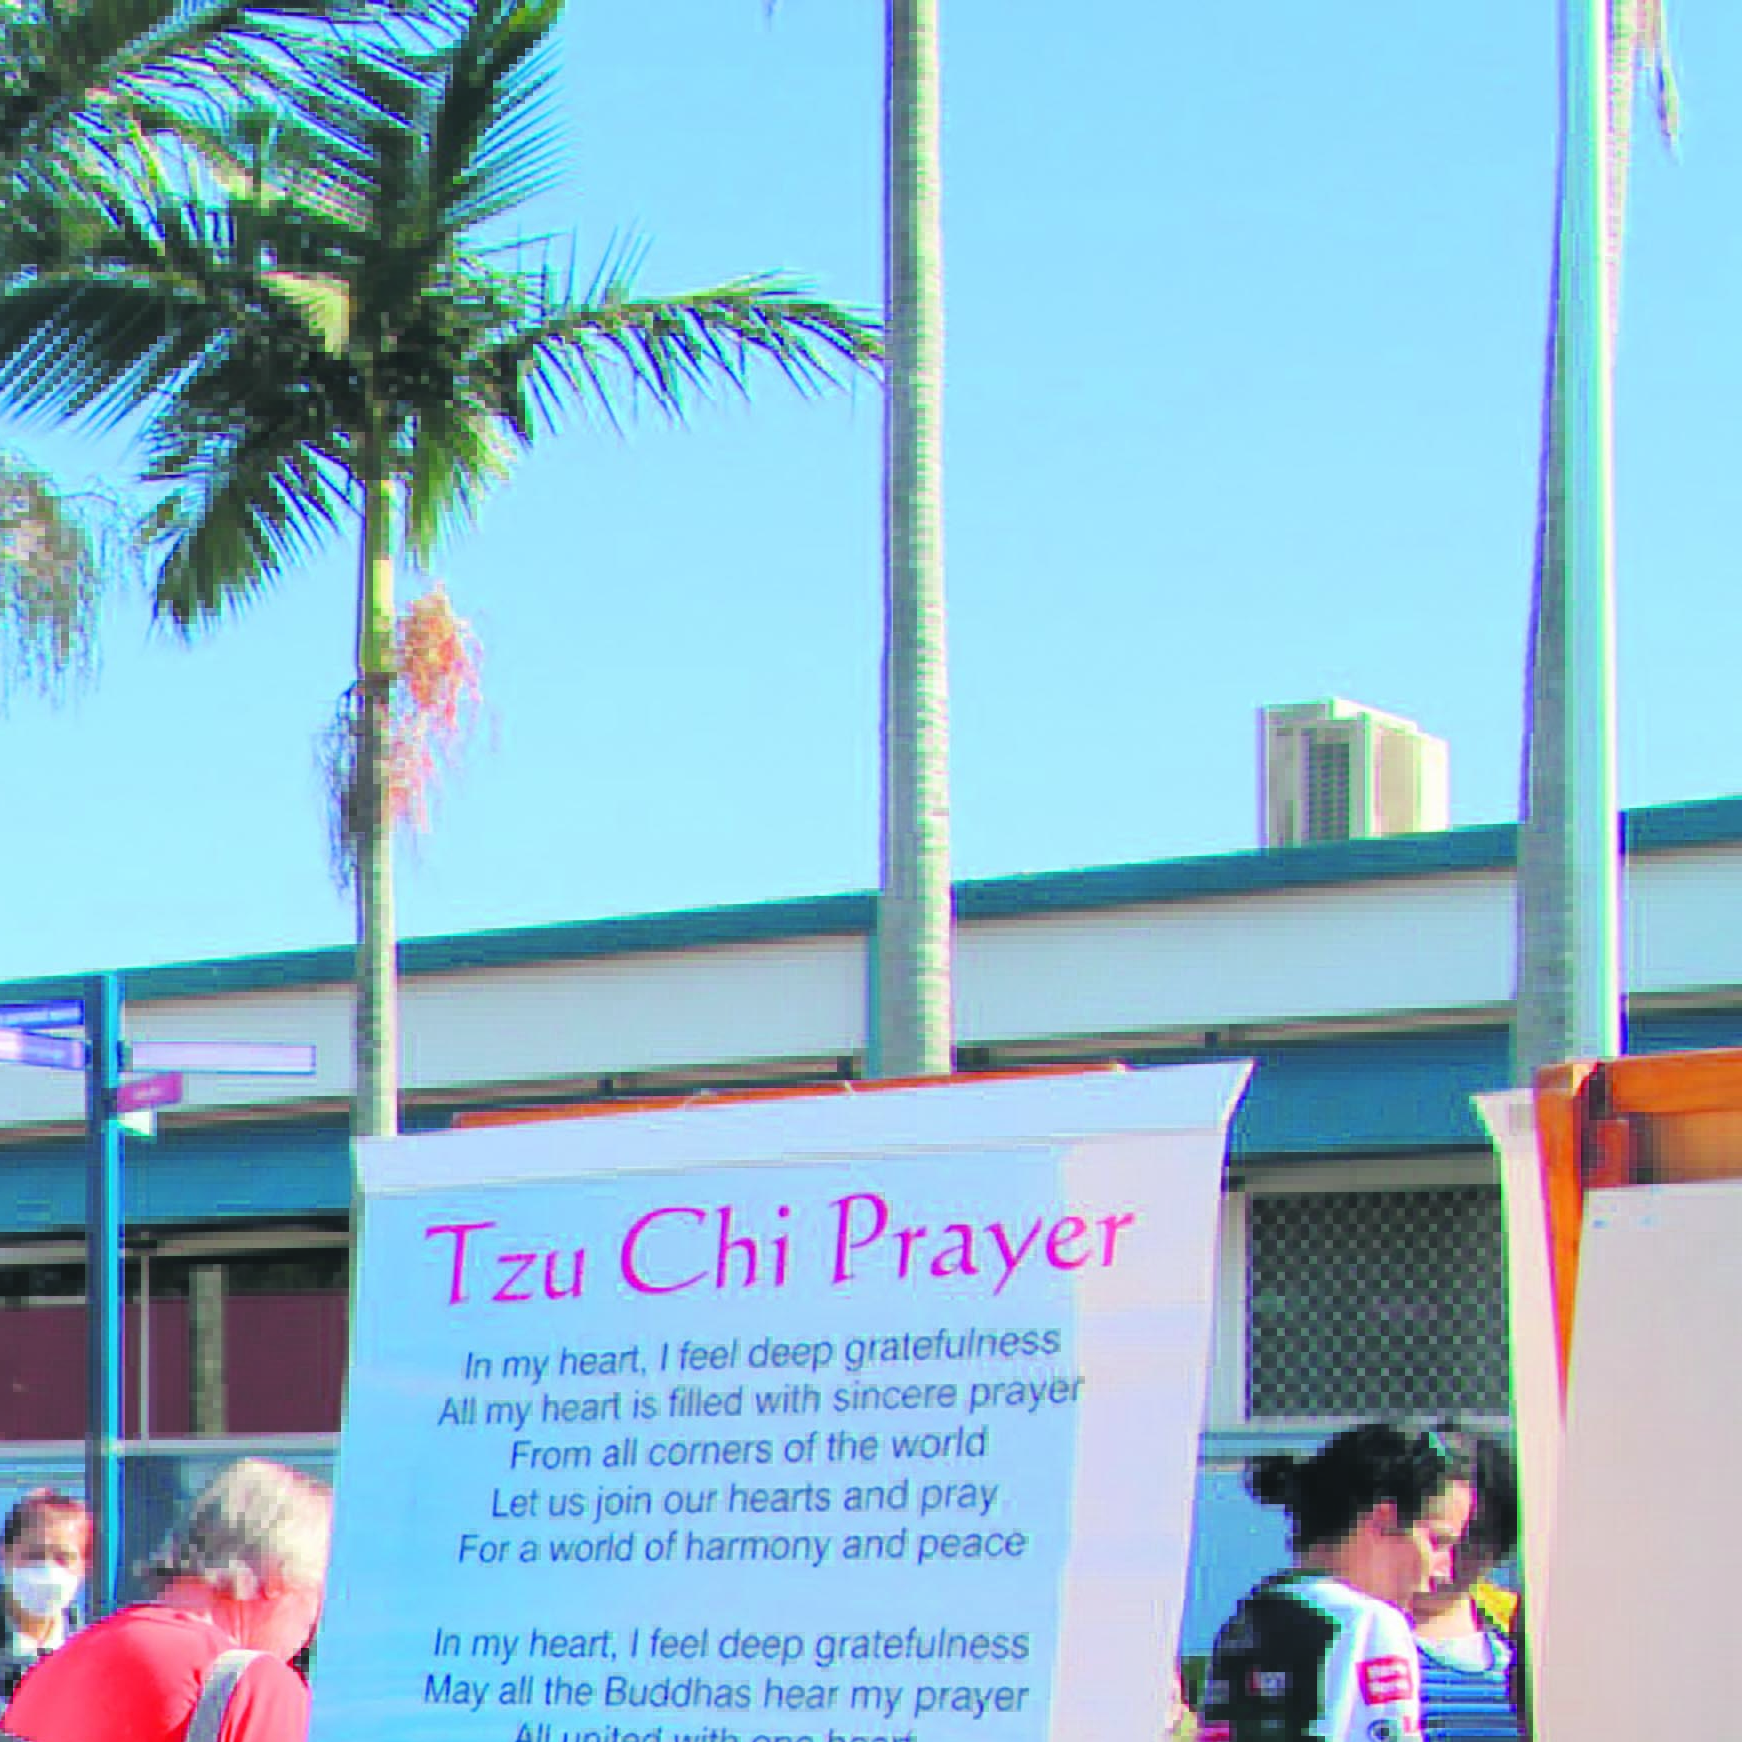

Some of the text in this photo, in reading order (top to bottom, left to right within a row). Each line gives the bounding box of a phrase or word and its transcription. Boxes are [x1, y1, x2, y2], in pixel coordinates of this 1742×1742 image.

[425, 1192, 1134, 1305] Tzu Chi Prayer
[465, 1327, 1061, 1386] In my heart, I feel deep gratefulness
[437, 1375, 1085, 1433] All my heart is filled with sincere prayer
[510, 1424, 989, 1470] From all corners of the world
[492, 1477, 999, 1524] Let us join our hearts and pray
[459, 1526, 1029, 1568] For a world of harmony and peace
[434, 1625, 1029, 1668] In my heart, I feel deep gratefulness
[425, 1673, 1029, 1719] May all the Buddhas hear my prayer
